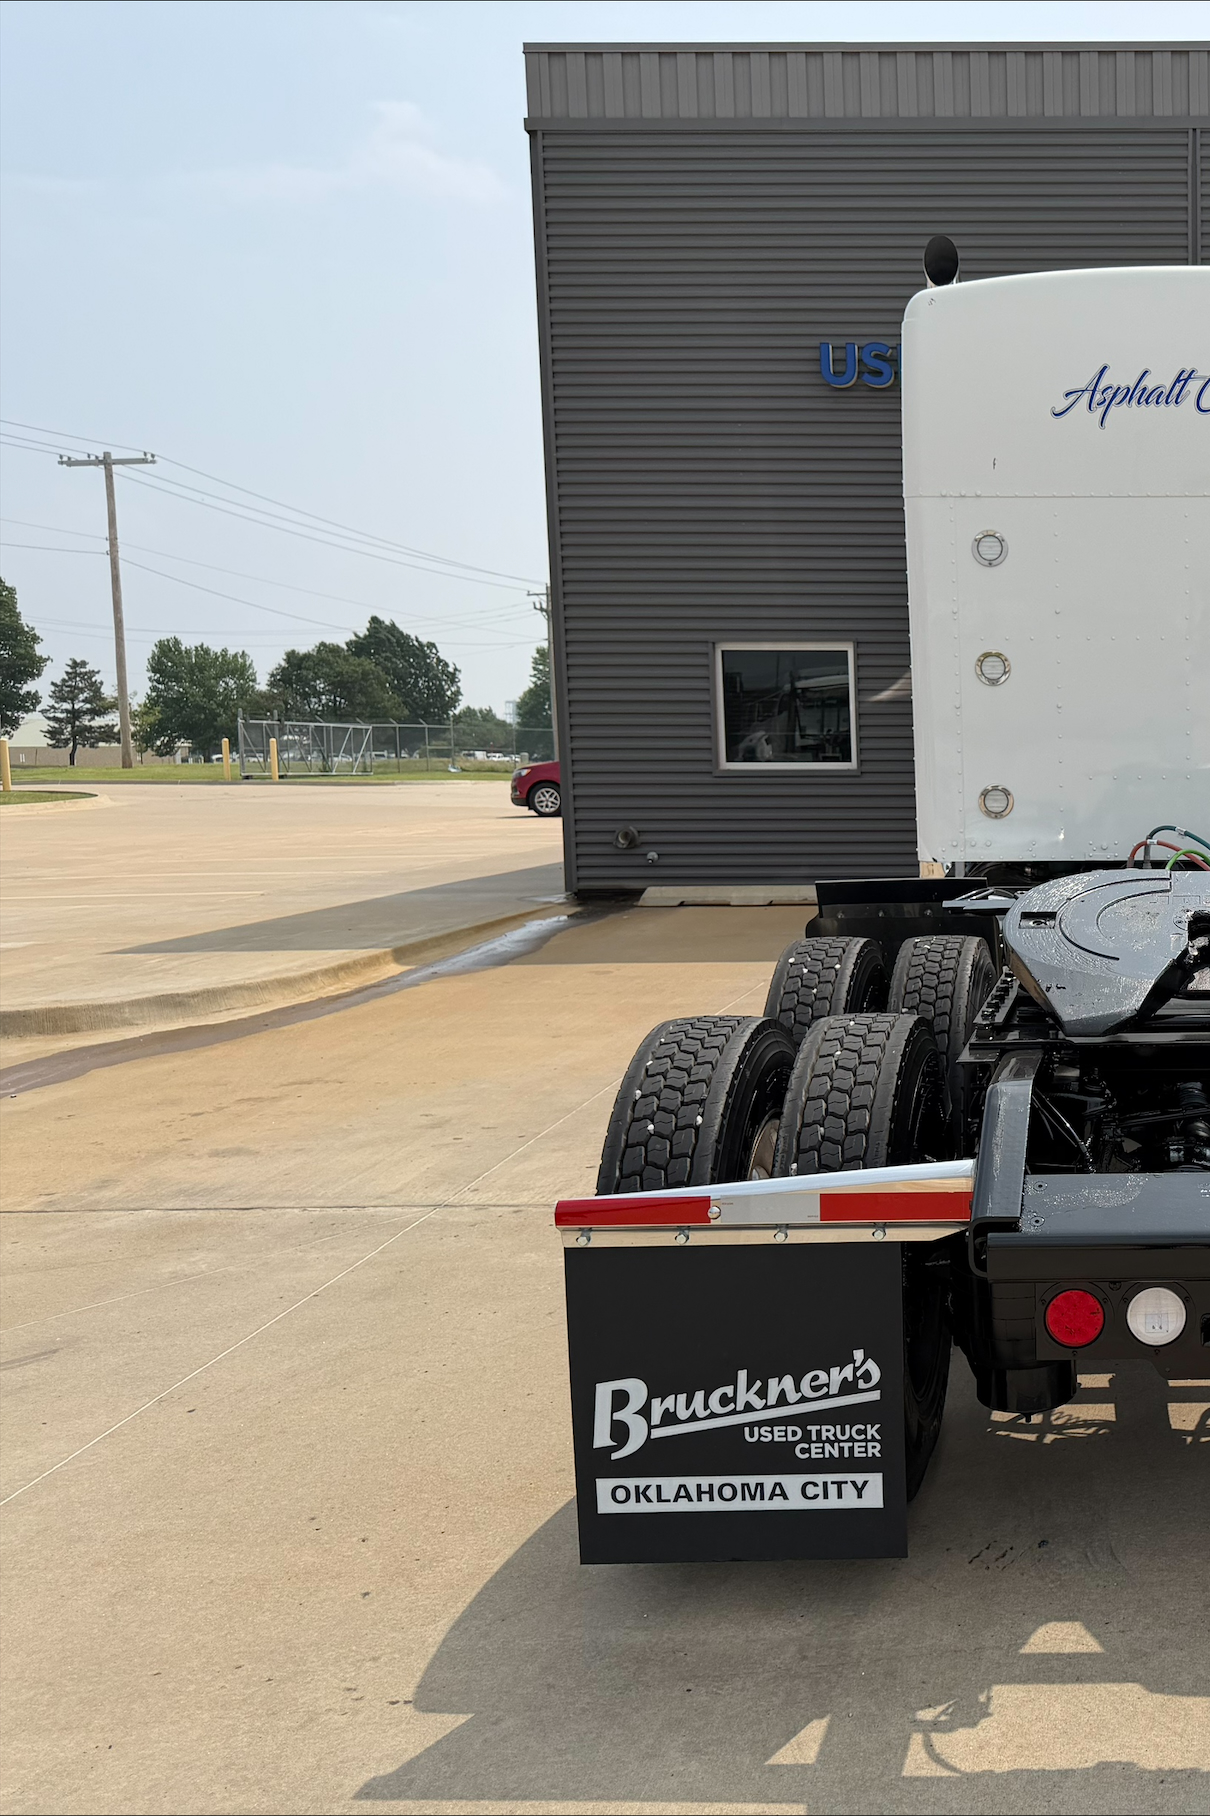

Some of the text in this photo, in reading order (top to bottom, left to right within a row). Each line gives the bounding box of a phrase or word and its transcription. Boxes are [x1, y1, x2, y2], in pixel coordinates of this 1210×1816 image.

[819, 342, 902, 388] US
[1051, 363, 1204, 430] Asphalt
[593, 1349, 881, 1460] Bruckner's
[743, 1424, 881, 1442] USED TRUCK
[794, 1442, 881, 1459] CENTER
[610, 1479, 869, 1505] OKLAHOMA CITY
